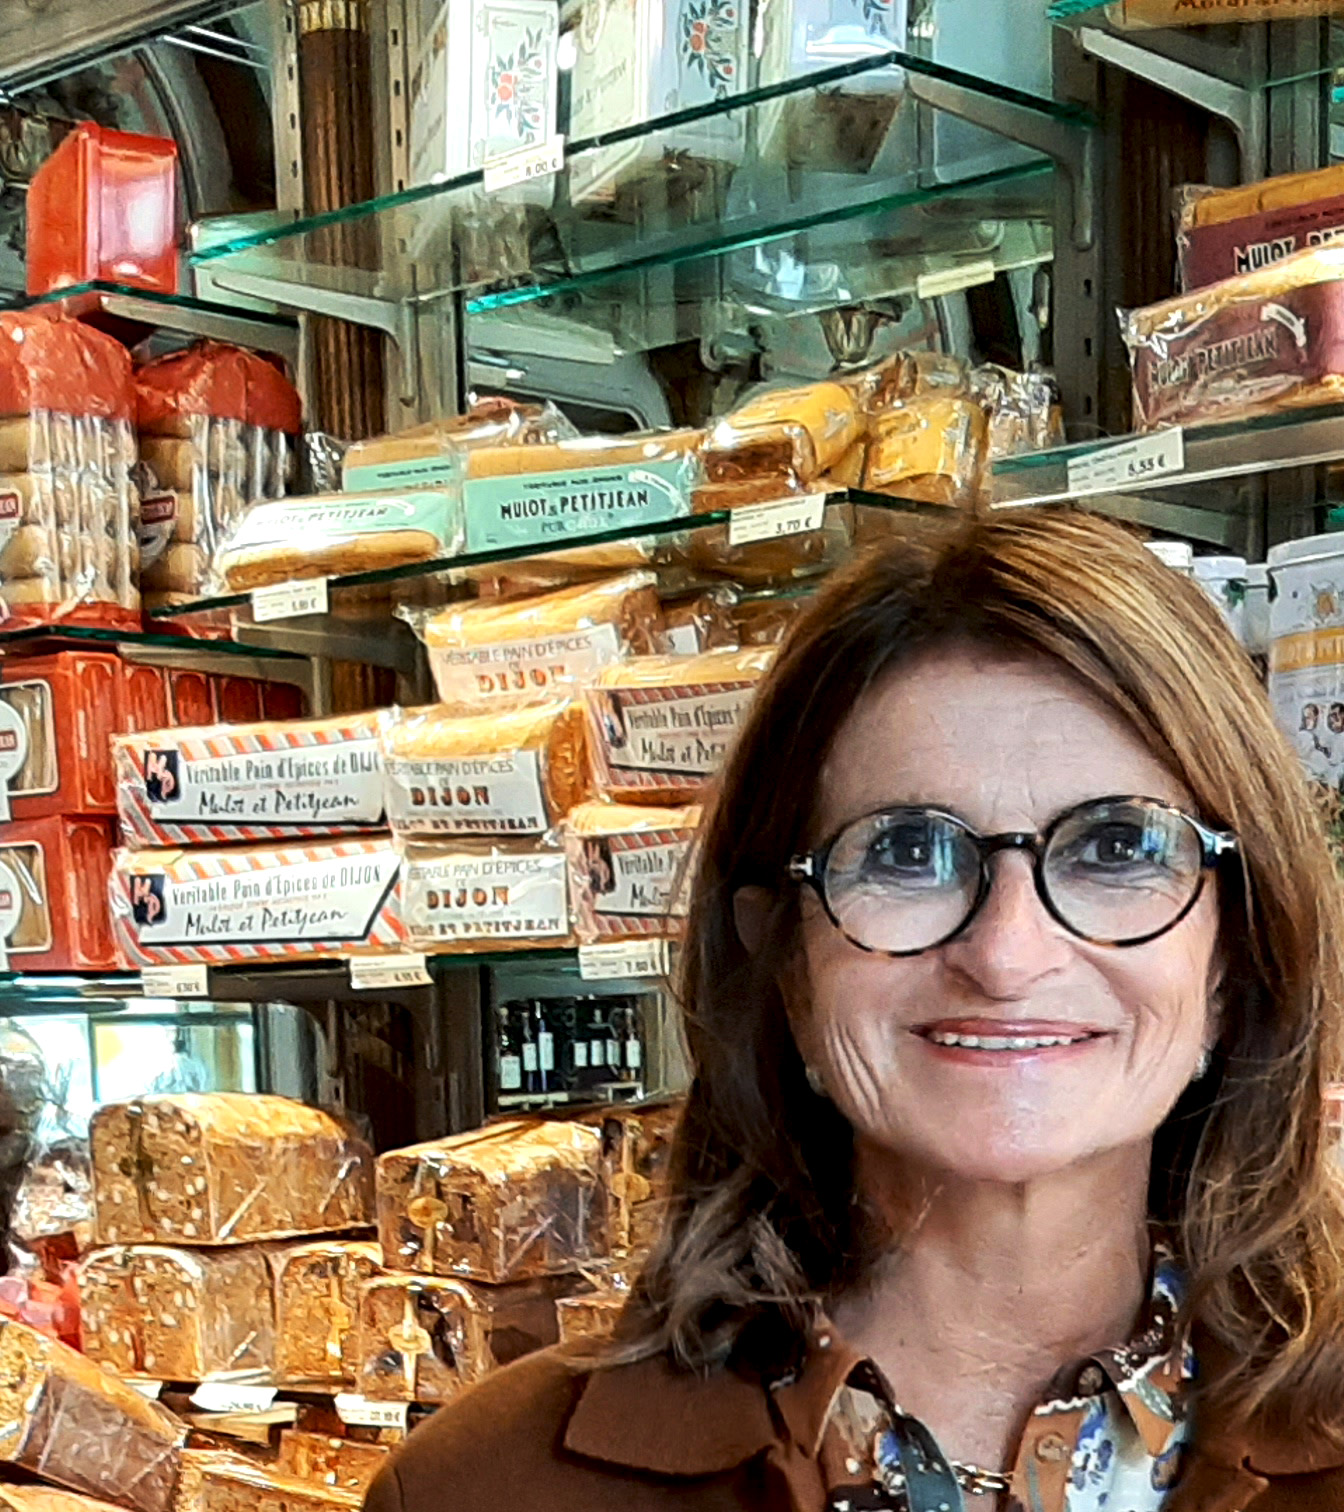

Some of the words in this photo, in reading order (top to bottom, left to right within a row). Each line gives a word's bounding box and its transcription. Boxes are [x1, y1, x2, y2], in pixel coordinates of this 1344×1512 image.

[308, 507, 388, 521] PETITJEAN
[500, 499, 546, 520] MULOT
[560, 490, 648, 513] PETITJEAN
[776, 520, 800, 534] 3,70
[805, 516, 812, 528] €
[503, 647, 533, 660] PAIN
[476, 665, 565, 693] DIJON
[246, 759, 272, 779] Pain
[333, 757, 347, 775] de
[199, 791, 244, 815] Mulot
[253, 799, 266, 814] et
[275, 790, 359, 818] Petitjean
[411, 786, 489, 806] DIJON
[453, 816, 538, 831] PETITJEAN
[454, 865, 478, 878] PAIN
[234, 879, 260, 900] Pain
[322, 872, 336, 890] de
[340, 865, 381, 886] DIJON
[427, 887, 509, 909] DIJON
[185, 907, 231, 936] Mulot
[239, 915, 254, 931] et
[261, 907, 348, 935] Petitjean
[440, 923, 456, 935] ET
[464, 918, 559, 933] PETITJEAN
